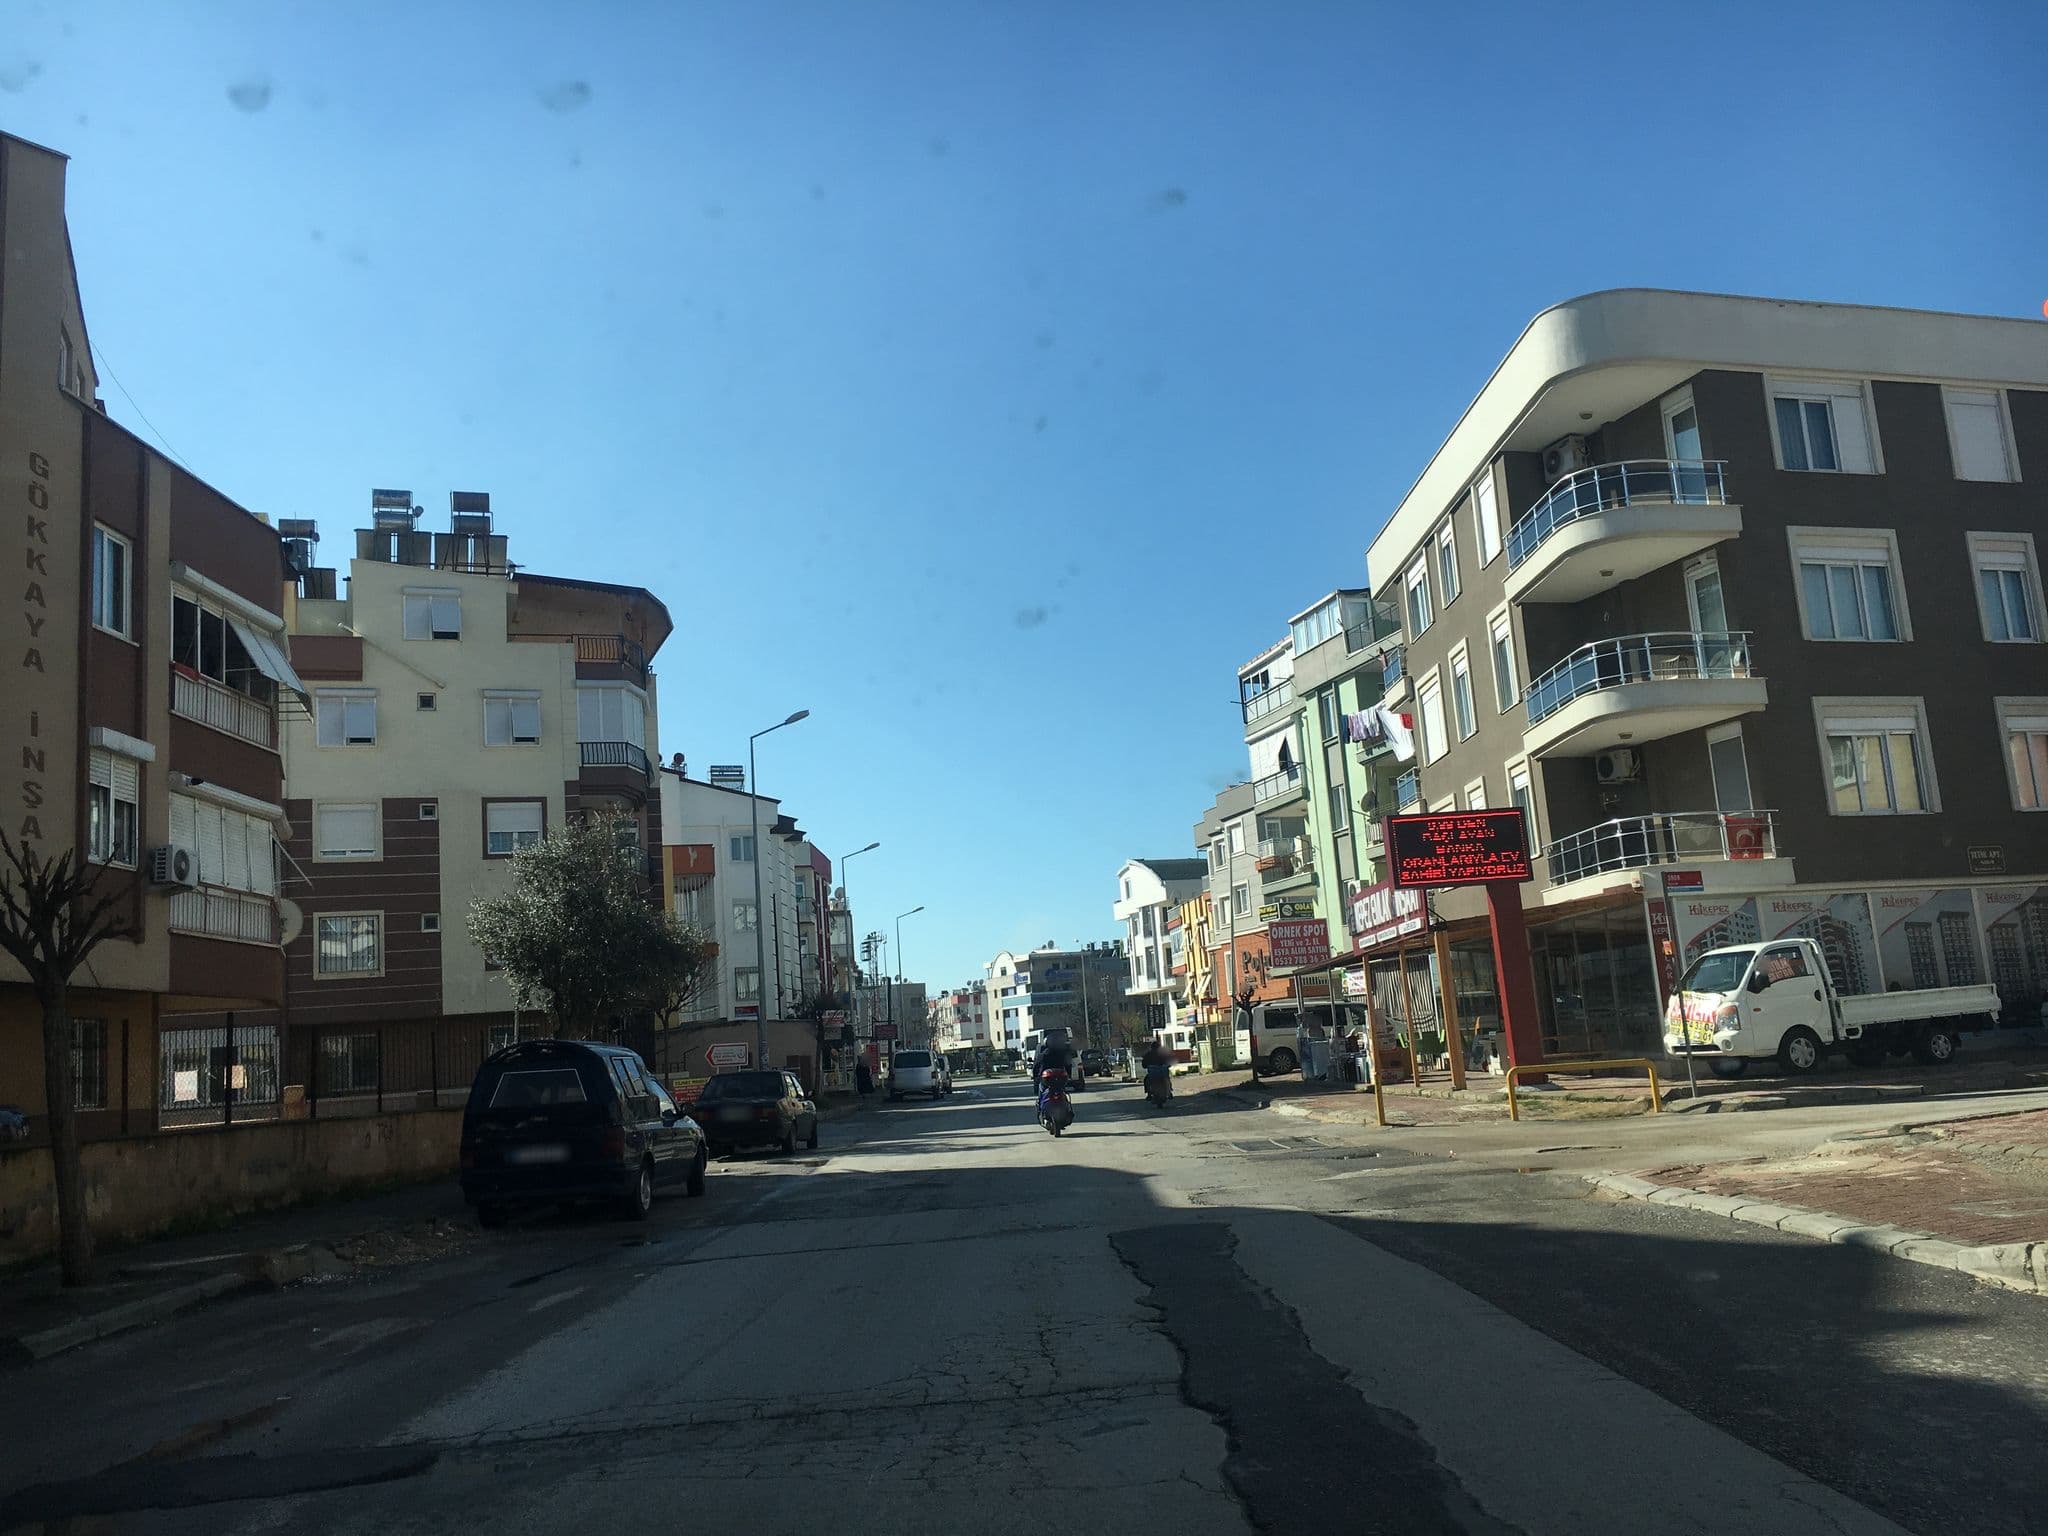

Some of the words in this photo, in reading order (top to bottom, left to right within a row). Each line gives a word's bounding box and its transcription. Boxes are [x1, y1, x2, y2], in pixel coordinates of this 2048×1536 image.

[22, 451, 50, 674] GÖKKAYA
[1271, 923, 1301, 939] ÖRNEK
[1303, 924, 1325, 936] SPOT
